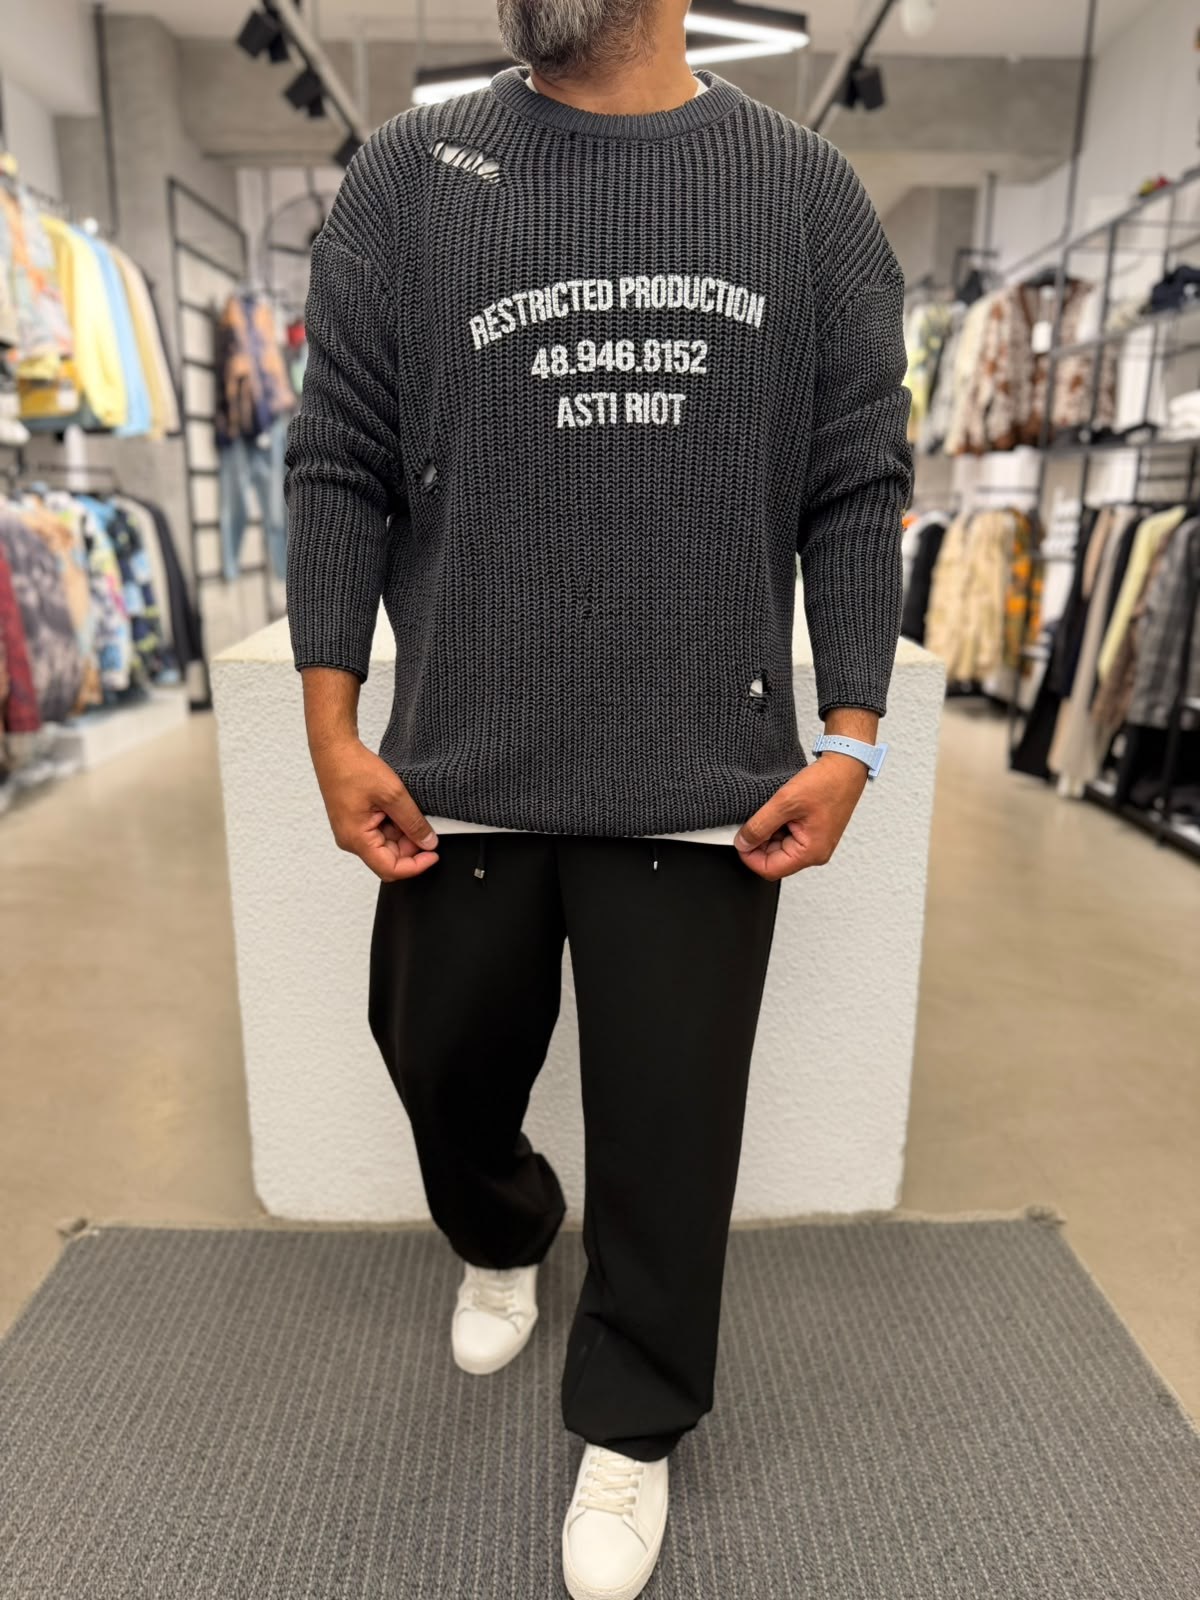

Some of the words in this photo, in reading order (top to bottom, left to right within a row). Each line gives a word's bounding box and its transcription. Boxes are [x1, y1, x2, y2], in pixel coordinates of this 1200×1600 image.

[469, 279, 613, 350] RESTRICTED
[619, 275, 766, 328] PRODUCTION
[531, 339, 708, 379] 48.946.8152
[557, 392, 617, 428] ASTI
[625, 392, 686, 425] RIOT
